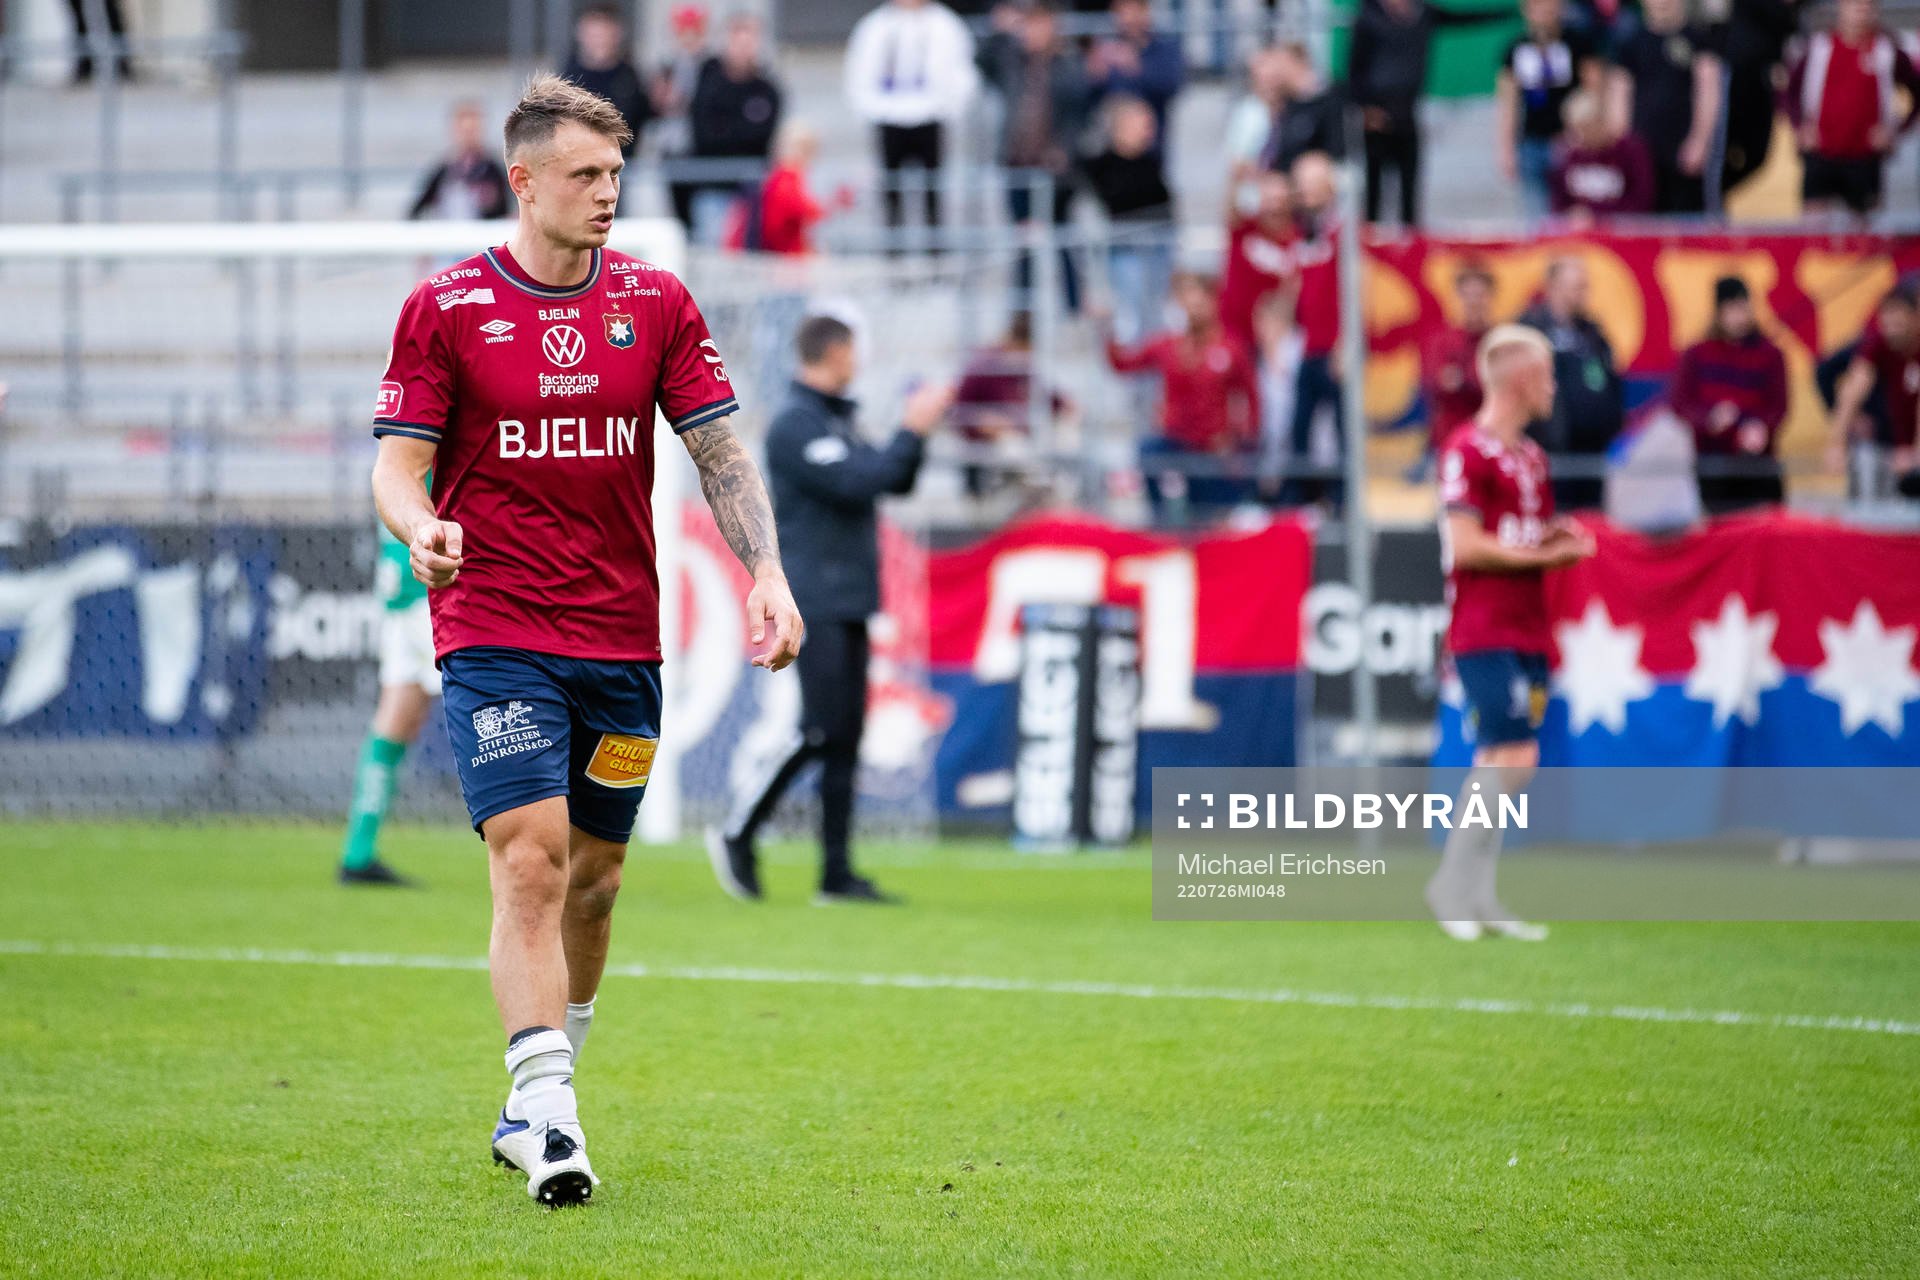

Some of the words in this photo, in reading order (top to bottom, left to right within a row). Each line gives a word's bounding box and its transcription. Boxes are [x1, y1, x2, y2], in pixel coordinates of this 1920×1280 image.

[450, 268, 482, 280] BYGG
[606, 290, 631, 299] ERNST
[538, 308, 580, 320] BJELIN
[485, 335, 514, 344] umbro
[538, 372, 599, 387] factoring
[498, 417, 639, 459] BJELIN
[478, 730, 541, 753] STIFTELSEN
[471, 738, 553, 768] DUNROSS&CO
[609, 759, 646, 776] GLASS
